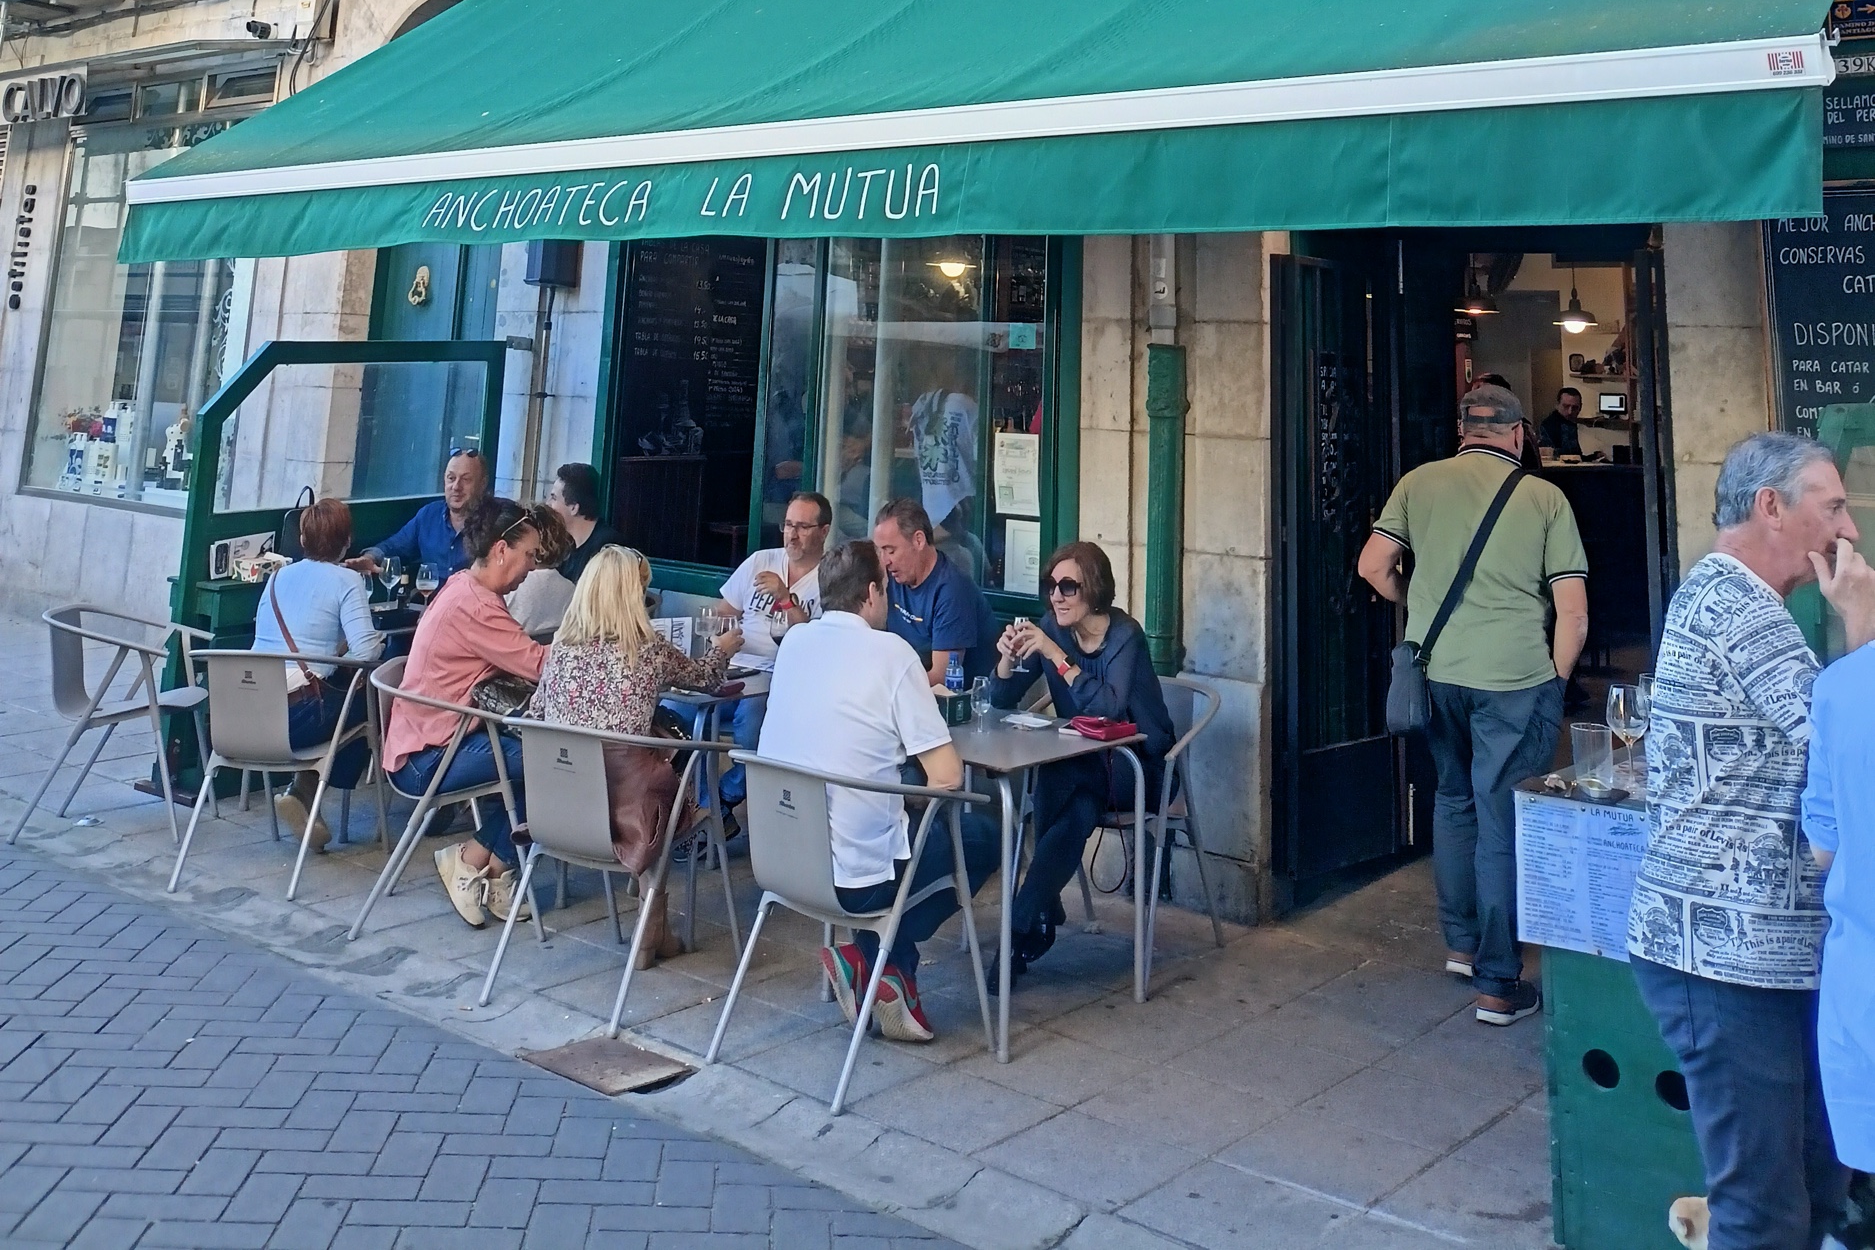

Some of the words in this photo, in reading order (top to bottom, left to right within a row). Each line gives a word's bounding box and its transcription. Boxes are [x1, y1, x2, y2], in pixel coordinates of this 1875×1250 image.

[2, 73, 85, 123] CALVO
[1827, 111, 1845, 125] DEL
[1823, 135, 1843, 145] MINO
[1845, 134, 1855, 144] DE
[422, 180, 652, 231] ANCHOATECA
[700, 173, 752, 218] LA
[780, 163, 941, 221] MUTUA
[8, 184, 37, 310] estilistas
[1780, 246, 1865, 265] CONSERVAS
[1792, 359, 1821, 372] PARA
[1831, 361, 1869, 373] CATAR
[1794, 379, 1808, 391] EN
[1816, 380, 1842, 394] BAR
[1796, 405, 1823, 419] COM
[1797, 426, 1811, 437] EN
[1591, 808, 1600, 817] LA
[1604, 810, 1634, 823] MUTUA
[1682, 824, 1698, 834] pair
[1700, 829, 1710, 838] of
[1603, 839, 1644, 852] ANCHOATECA
[1743, 939, 1765, 951] This
[1766, 934, 1774, 945] is
[1780, 934, 1795, 945] pair
